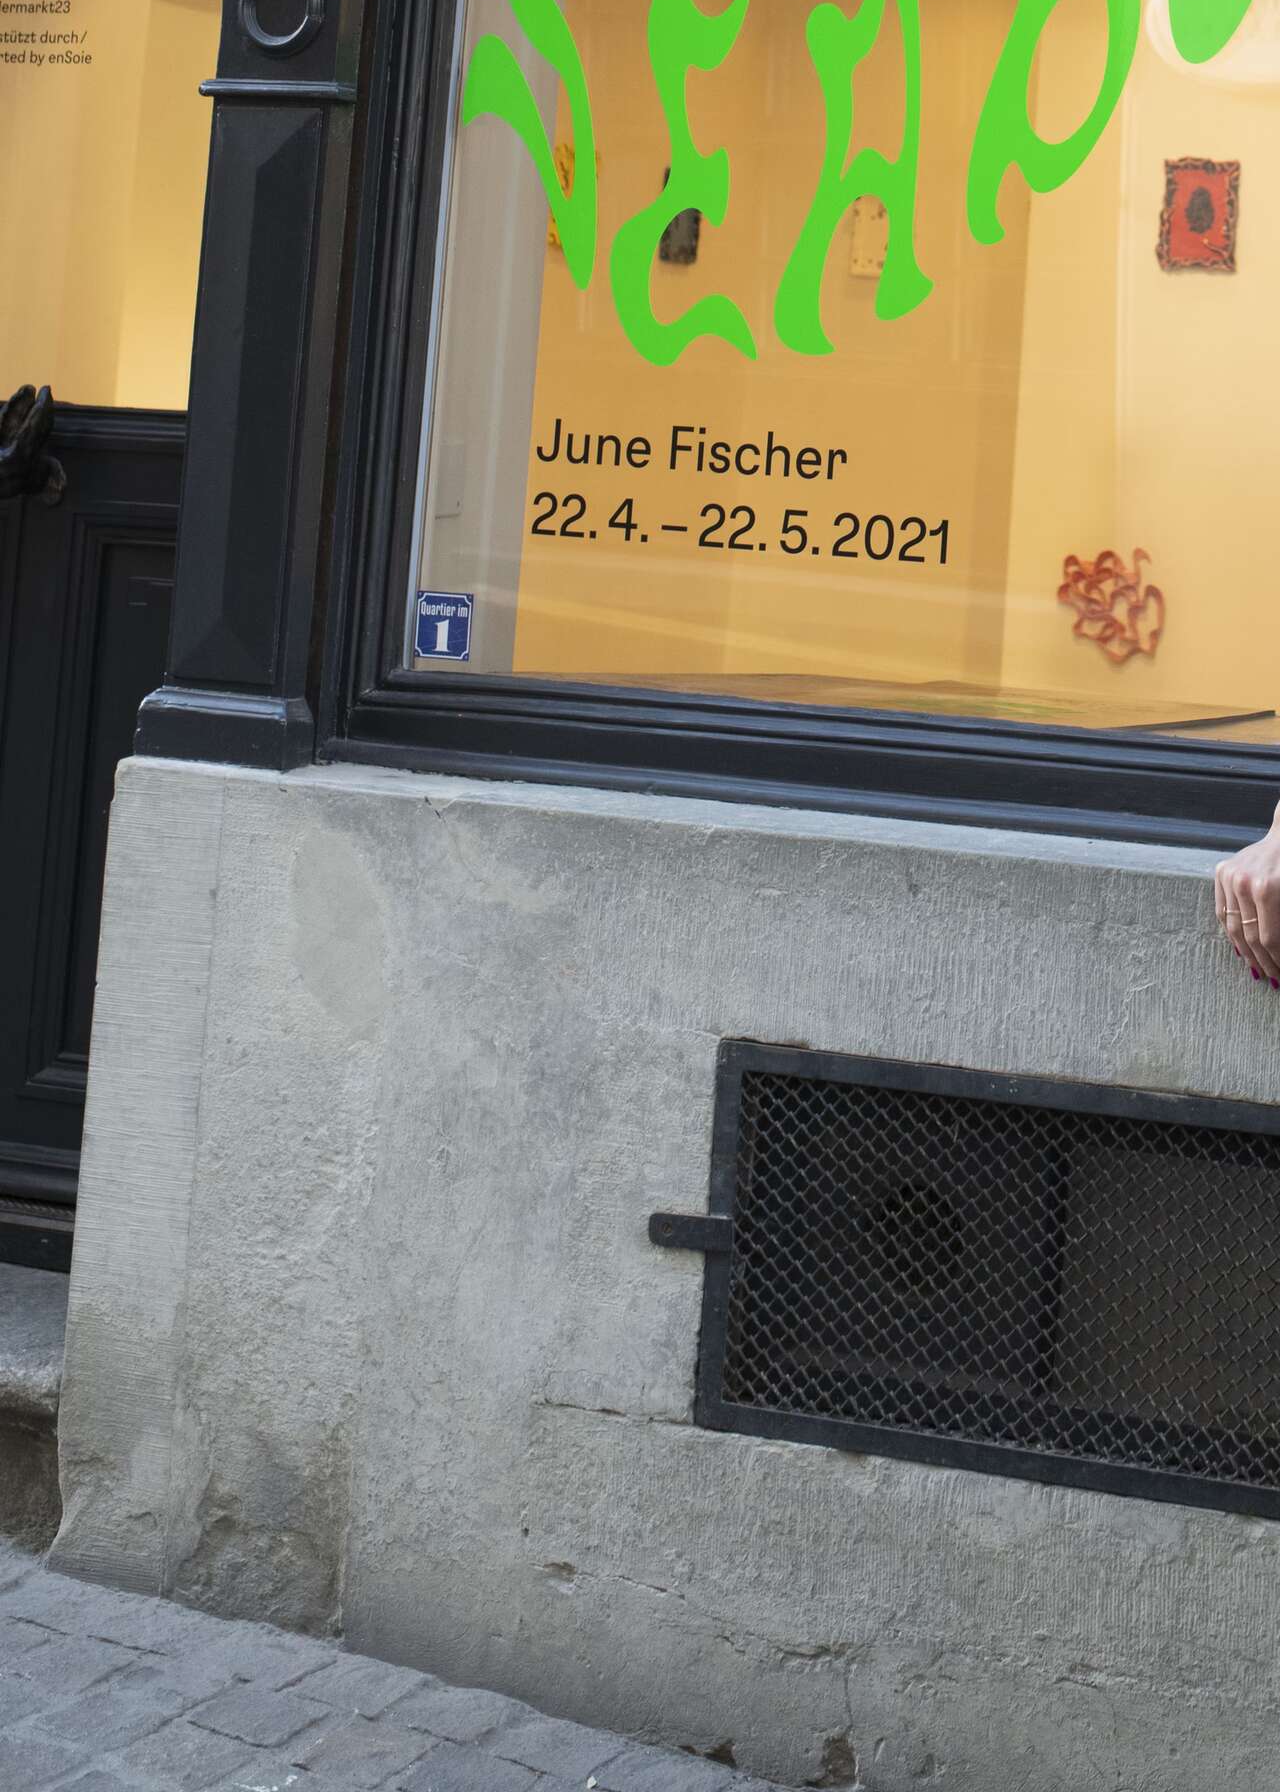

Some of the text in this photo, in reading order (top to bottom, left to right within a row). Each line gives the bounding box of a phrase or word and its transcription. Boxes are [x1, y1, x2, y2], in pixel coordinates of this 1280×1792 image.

[0, 0, 71, 14] ermarkt23
[29, 50, 45, 67] by
[48, 50, 92, 64] enSoie
[536, 418, 848, 480] June Fischer
[421, 601, 468, 617] Quartier im
[433, 619, 450, 652] 1
